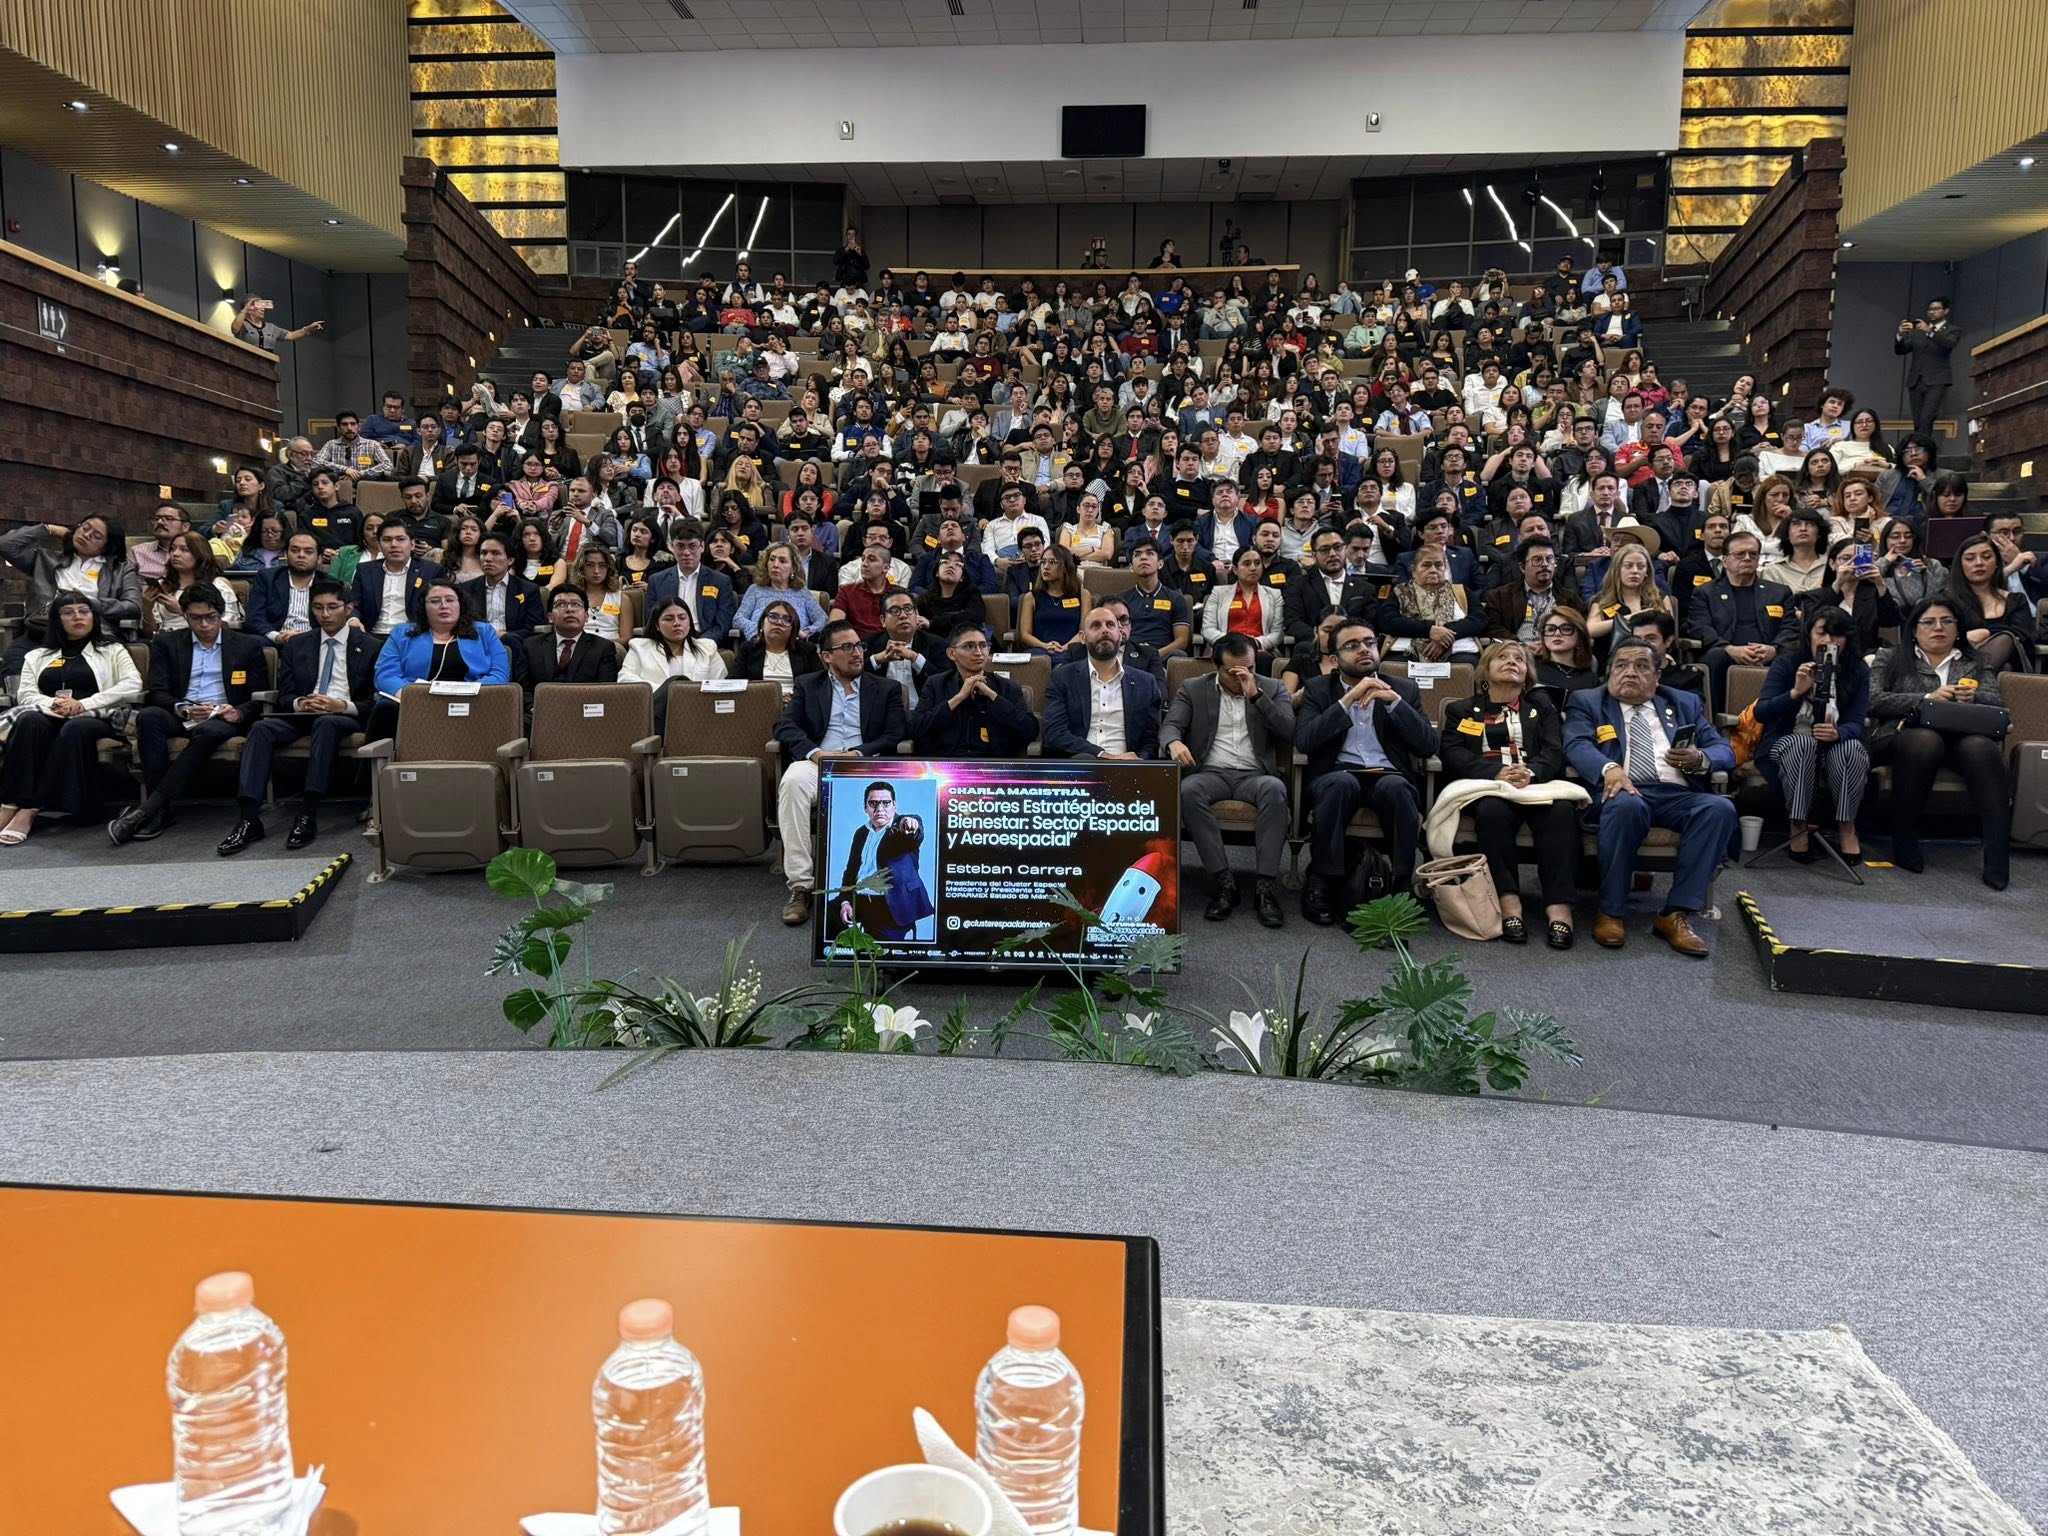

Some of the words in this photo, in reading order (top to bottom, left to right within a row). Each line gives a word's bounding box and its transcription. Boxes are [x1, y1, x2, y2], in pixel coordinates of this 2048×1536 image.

[948, 787, 1005, 796] CHARLA
[1007, 787, 1090, 797] MAGISTRAL
[947, 798, 1020, 814] Sectores
[1023, 799, 1125, 819] Estratégicos
[1128, 799, 1155, 815] del
[947, 813, 1030, 830] Bienestar:
[1032, 815, 1086, 831] Sector
[1089, 816, 1159, 836] Espacial
[946, 832, 958, 849] y
[946, 863, 1012, 875] Esteban
[1017, 864, 1083, 876] Carrera
